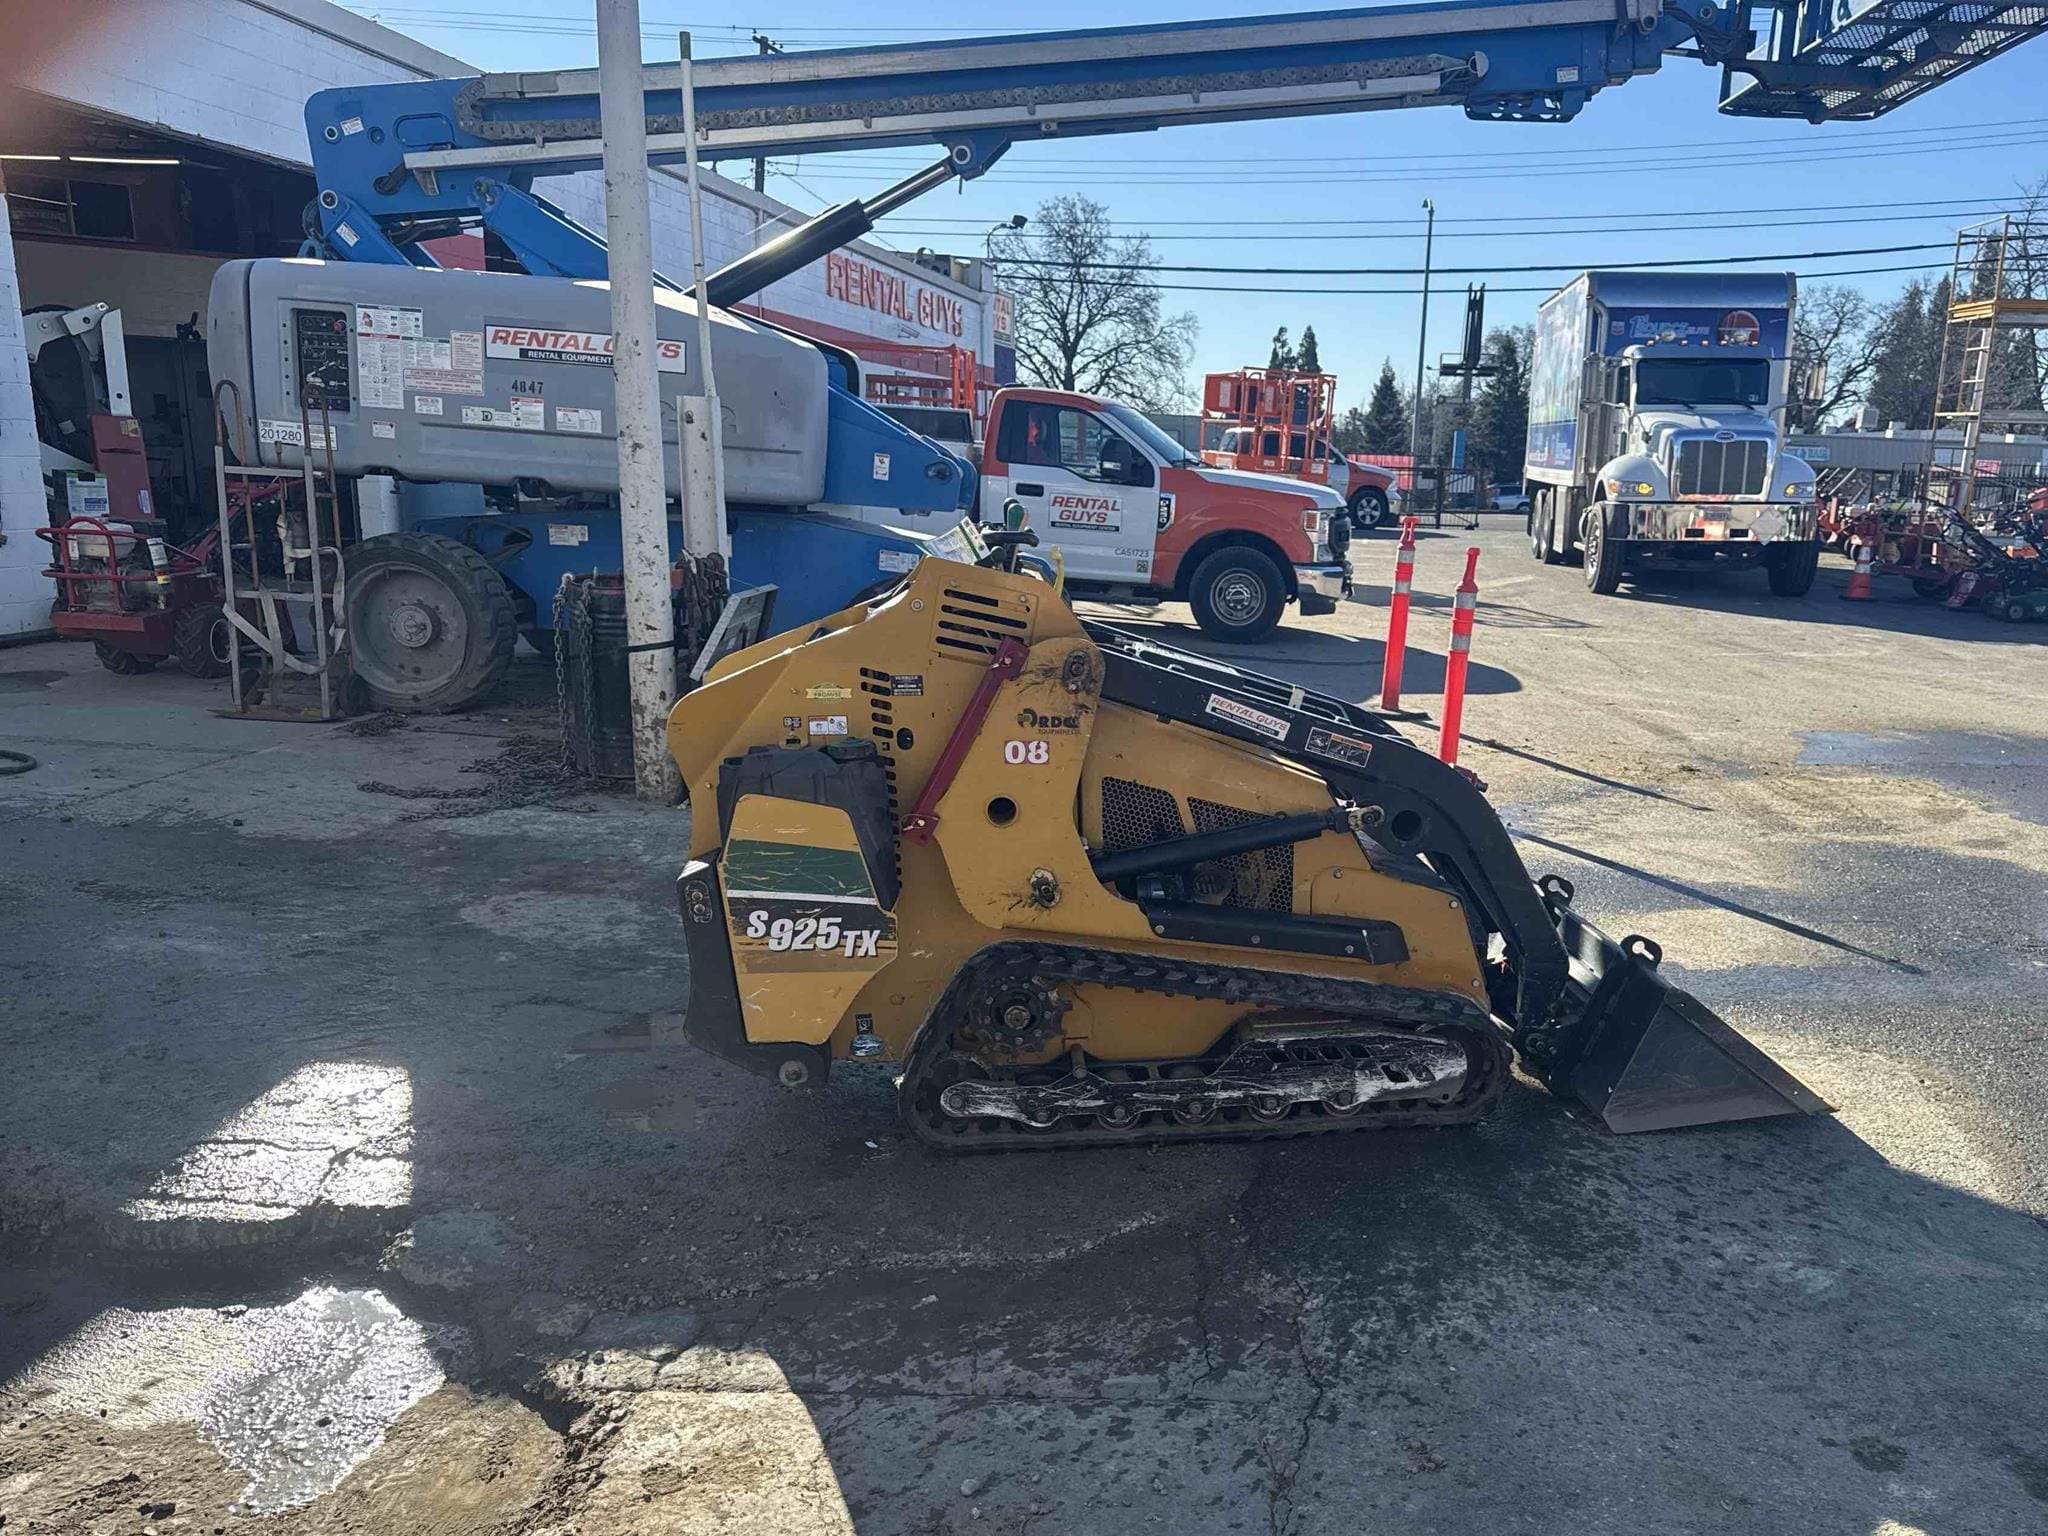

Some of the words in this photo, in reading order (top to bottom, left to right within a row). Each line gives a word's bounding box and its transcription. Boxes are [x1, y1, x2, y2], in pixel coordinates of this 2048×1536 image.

[827, 253, 913, 322] RENTAL
[918, 288, 962, 337] GUYS
[490, 329, 598, 352] RENTAL
[528, 350, 560, 360] RENTAL
[561, 352, 613, 365] EQUIPMENT
[511, 379, 544, 394] 4847
[260, 428, 302, 442] 201280
[1051, 496, 1120, 511] RENTAL
[1059, 509, 1108, 523] GUYS
[1211, 697, 1254, 719] RENTAL
[1256, 715, 1288, 731] GUYS
[1005, 740, 1049, 764] 08
